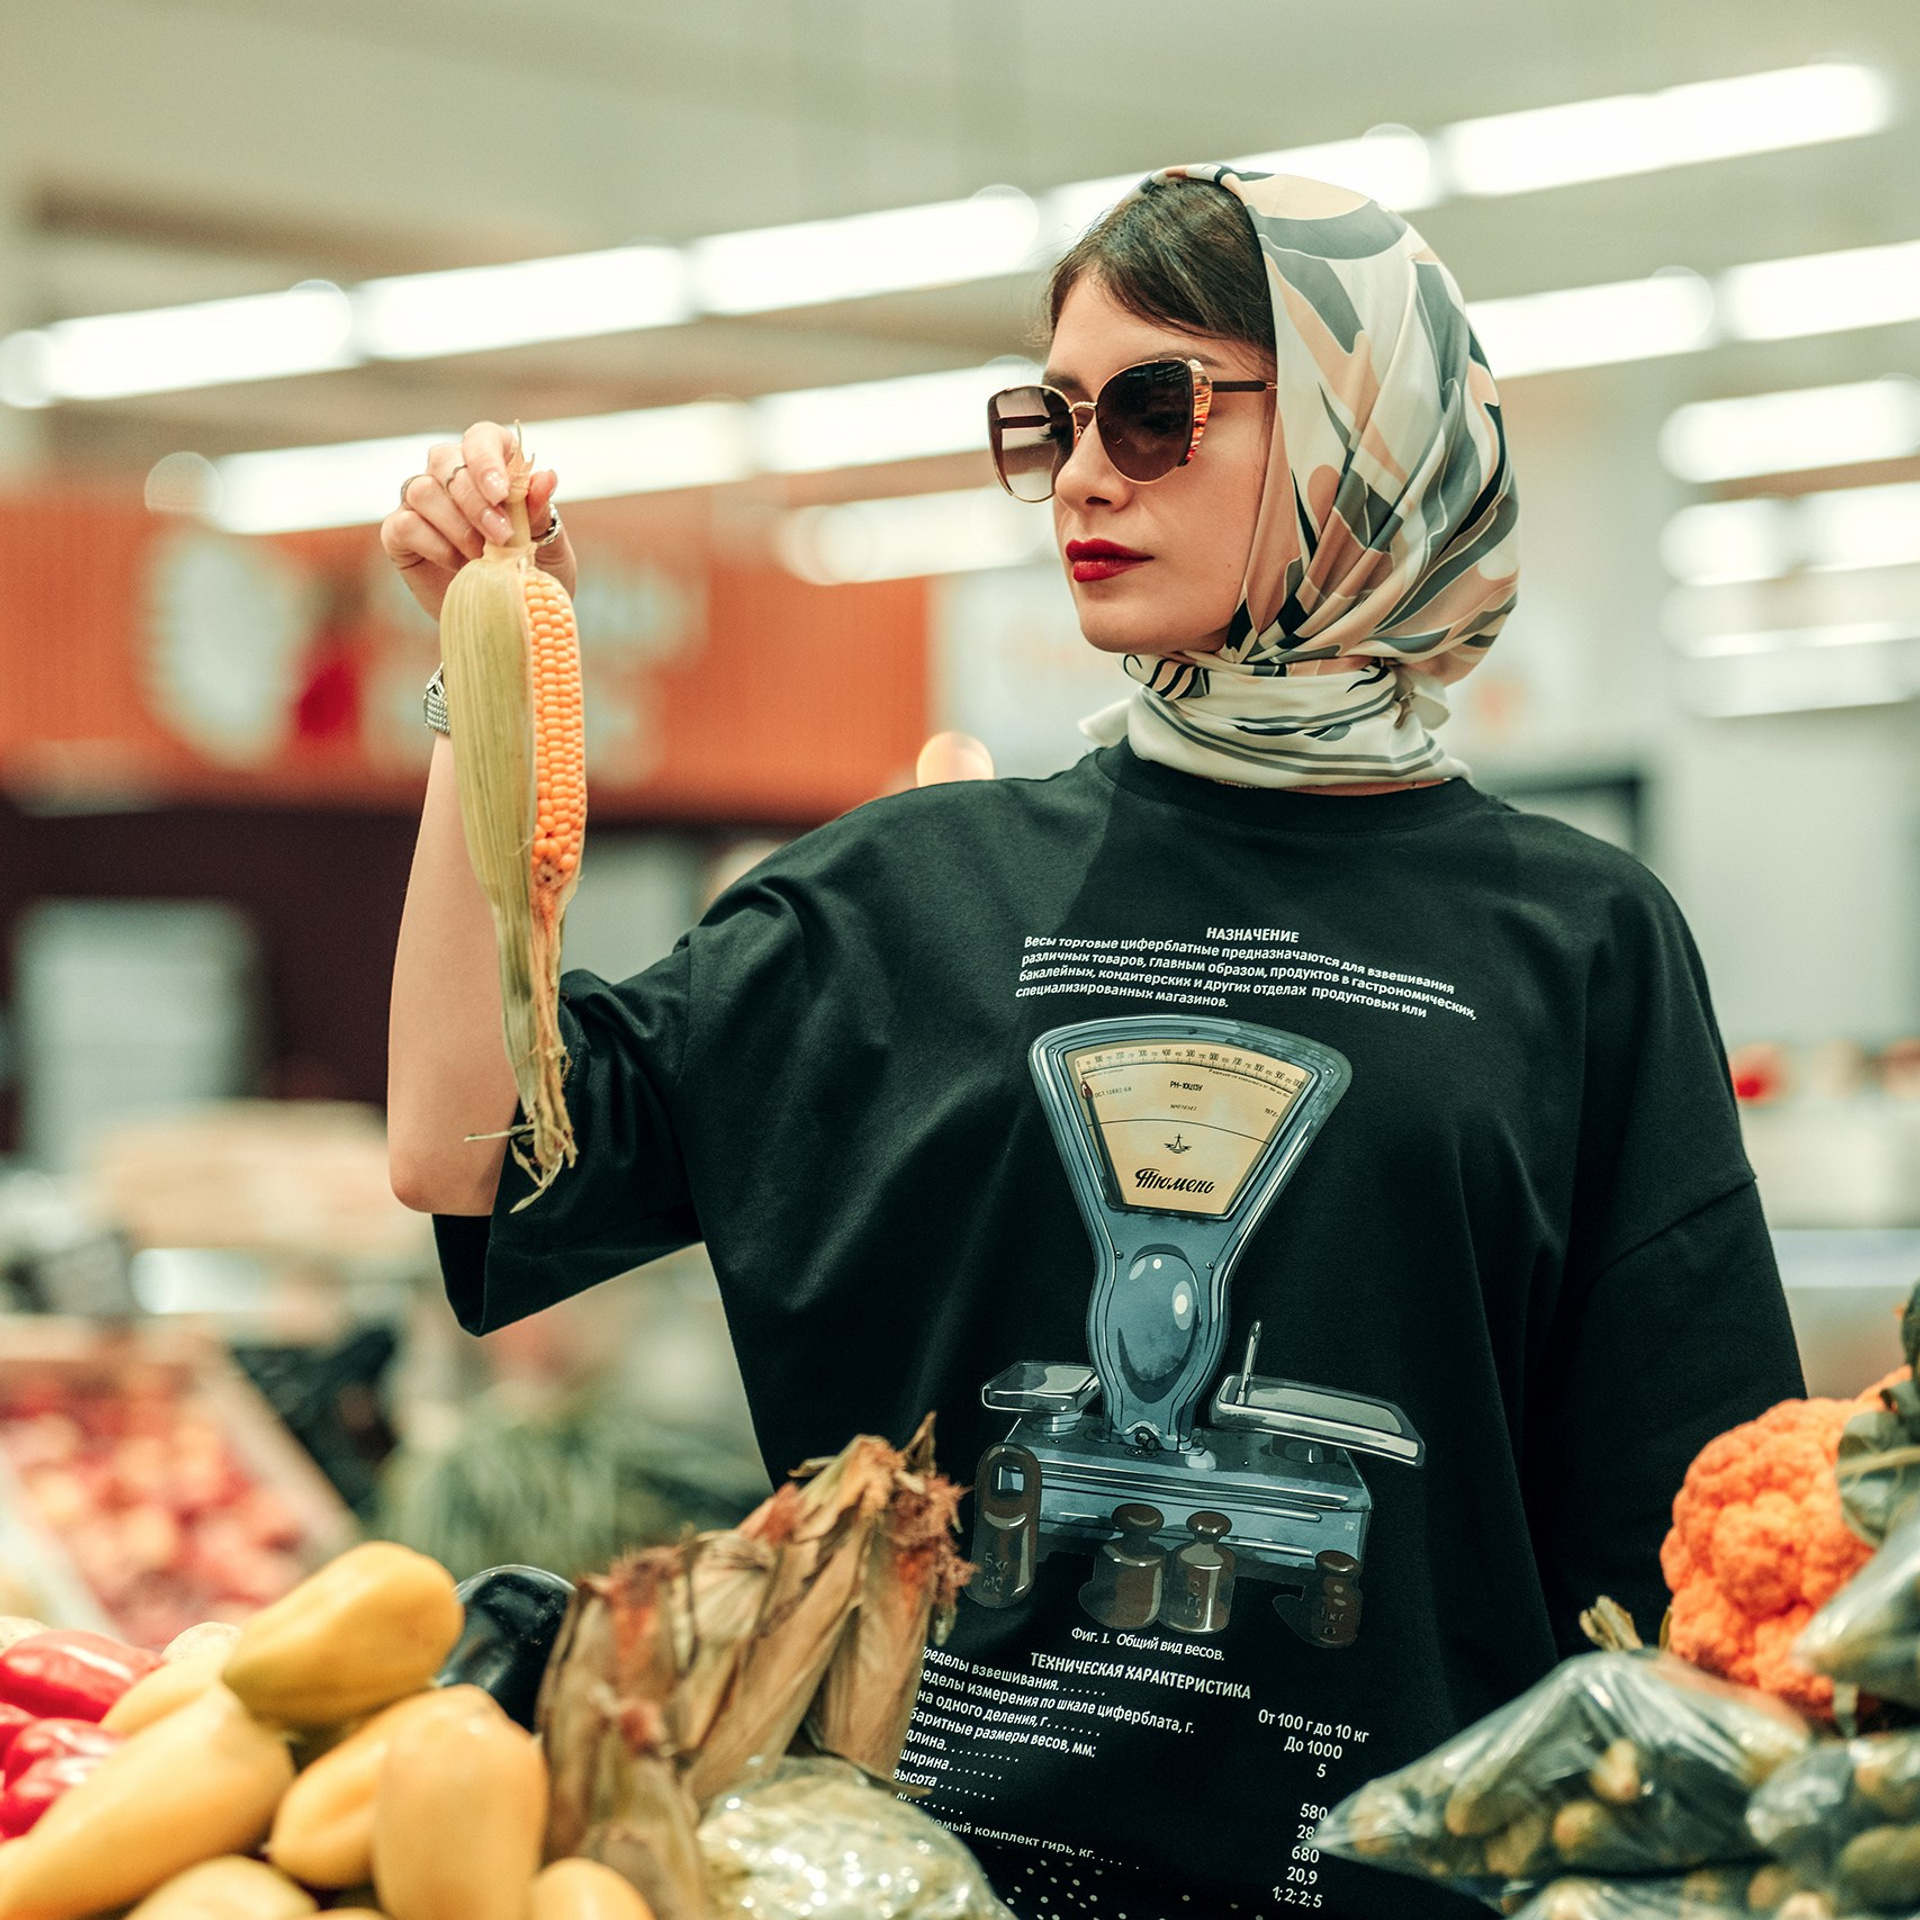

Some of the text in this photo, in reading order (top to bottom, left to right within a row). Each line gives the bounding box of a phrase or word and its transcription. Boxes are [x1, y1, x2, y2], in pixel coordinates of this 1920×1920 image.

[1206, 927, 1299, 943] НАЗНАЧЕНИЕ
[1024, 936, 1455, 994] Весы торговые циферблатные предназначаются для взвешивания
[1015, 983, 1229, 1008] специализированных магазинов.
[1019, 964, 1427, 1018] бакалейных, кондитерских и других отделах продуктовых или
[1022, 951, 1477, 1021] различных товаров, главным образом, продуктов в гастрономических,
[1135, 1168, 1215, 1194] Тюмень
[1071, 1627, 1098, 1643] Фиг.
[1116, 1633, 1160, 1651] Общий
[1160, 1640, 1183, 1655] вид
[1184, 1644, 1225, 1661] весов.
[922, 1646, 969, 1672] ределы
[1030, 1652, 1251, 1700] ТЕХНИЧЕСКАЯ ХАРАКТЕРИСТИКА
[917, 1690, 934, 1704] на
[936, 1695, 983, 1718] одного
[983, 1709, 1038, 1728] деления,
[967, 1683, 1038, 1707] измерения
[1040, 1698, 1055, 1709] по
[1056, 1699, 1095, 1714] шкале
[1097, 1705, 1183, 1734] циферблата,
[1185, 1721, 1195, 1734] г.
[909, 1707, 1097, 1758] баритные размеры весов, мм:
[1258, 1709, 1370, 1743] От 100 г до 10 кг
[1284, 1736, 1343, 1760] До 1000
[1316, 1763, 1327, 1778] 5
[1300, 1803, 1328, 1821] 580
[974, 1826, 1040, 1847] комплект
[1042, 1840, 1075, 1856] гирь,
[1296, 1824, 1315, 1840] 28
[1292, 1846, 1320, 1863] 680
[1286, 1866, 1318, 1886] 20,9
